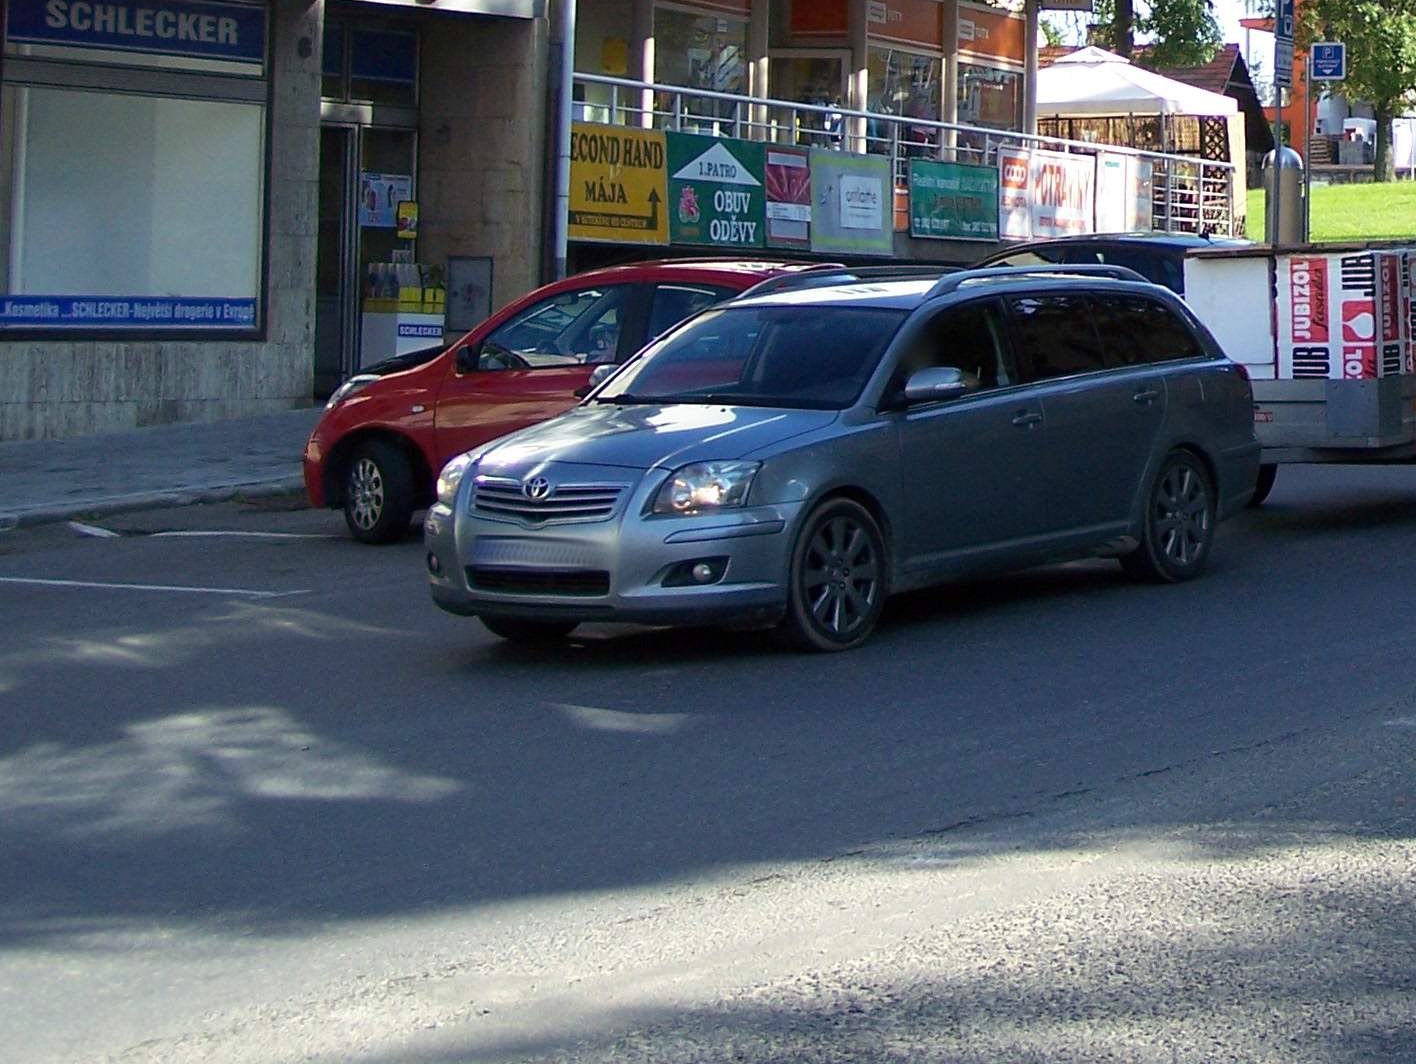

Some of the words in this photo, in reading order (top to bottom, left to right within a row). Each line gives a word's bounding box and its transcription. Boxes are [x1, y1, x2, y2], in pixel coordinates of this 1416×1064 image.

[570, 132, 621, 166] ECOND
[622, 138, 664, 170] HAND
[698, 161, 738, 179] 1.PATRO
[584, 175, 629, 204] MÁJA
[713, 189, 752, 214] OBUV
[1033, 163, 1091, 210] POTRAVINY
[709, 213, 758, 243] ODĚVY
[1341, 255, 1376, 297] JUB
[174, 303, 214, 321] drogerie
[216, 306, 222, 319] v
[1292, 261, 1311, 340] JUBIZOL
[1381, 257, 1392, 338] JUBIZOL
[399, 325, 443, 336] SCHLECKER
[1293, 347, 1330, 379] UB
